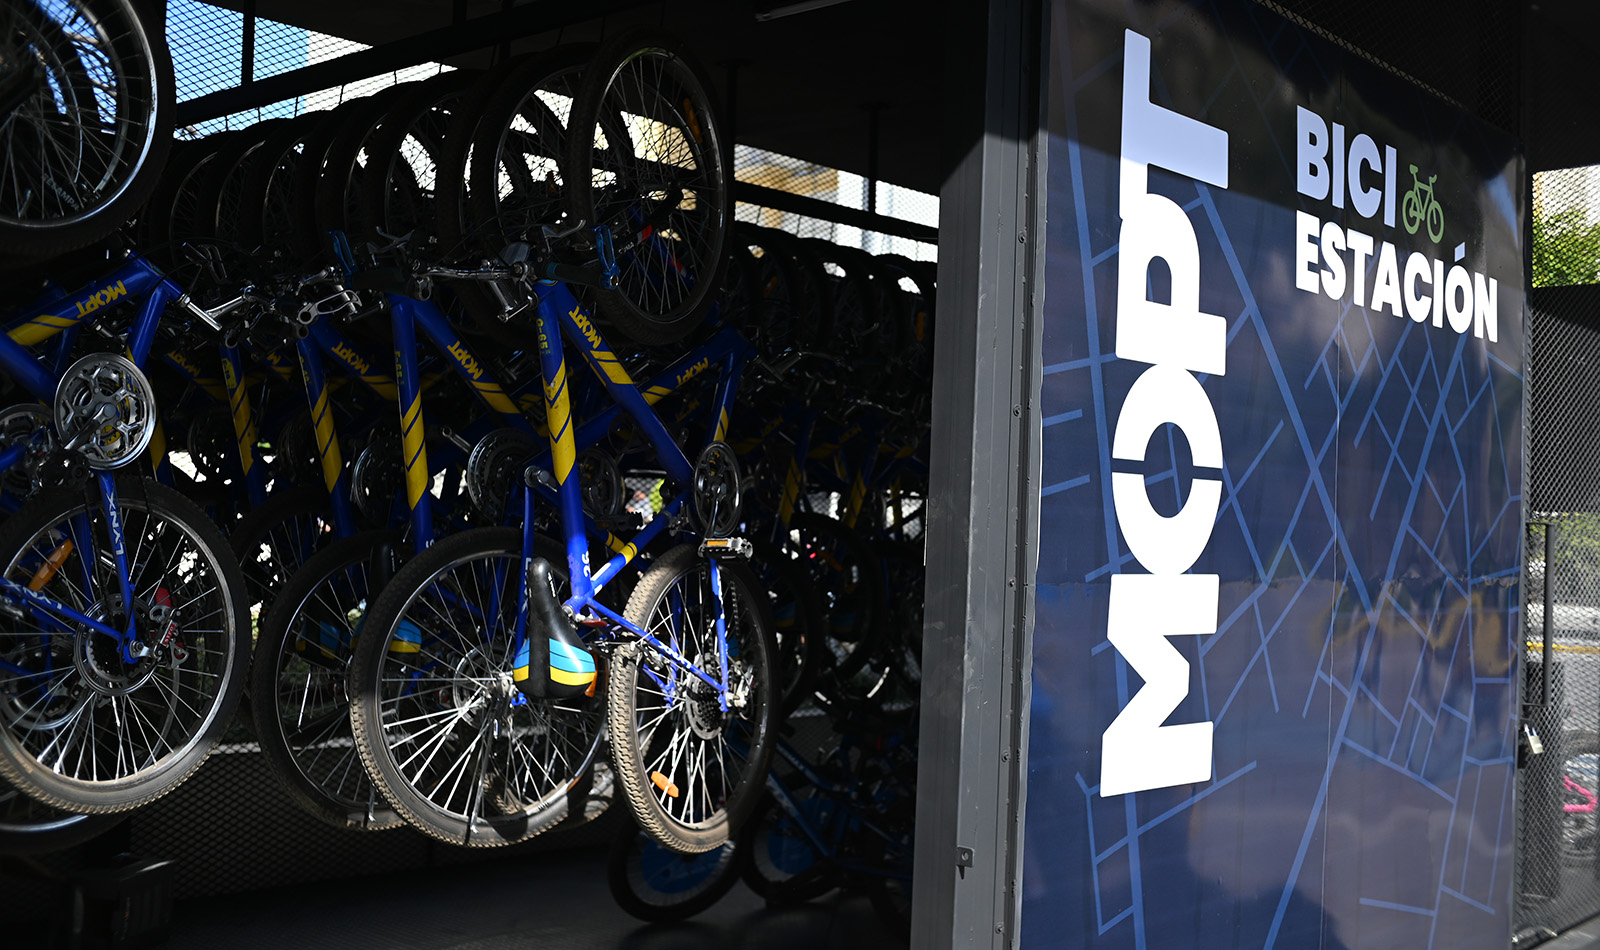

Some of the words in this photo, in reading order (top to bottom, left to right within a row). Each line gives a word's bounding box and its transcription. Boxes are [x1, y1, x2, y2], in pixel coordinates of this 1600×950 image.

[1297, 105, 1397, 228] BICI
[1296, 210, 1498, 343] ESTACIÓN
[76, 280, 128, 319] MOPT
[569, 305, 602, 349] MOPT
[168, 350, 201, 377] MOPT
[331, 341, 370, 375] MOPT
[447, 340, 484, 380] MOPT
[677, 357, 709, 387] MOPT
[1101, 29, 1229, 797] MOPT
[105, 490, 125, 556] LYNX
[4, 579, 63, 610] LYNX
